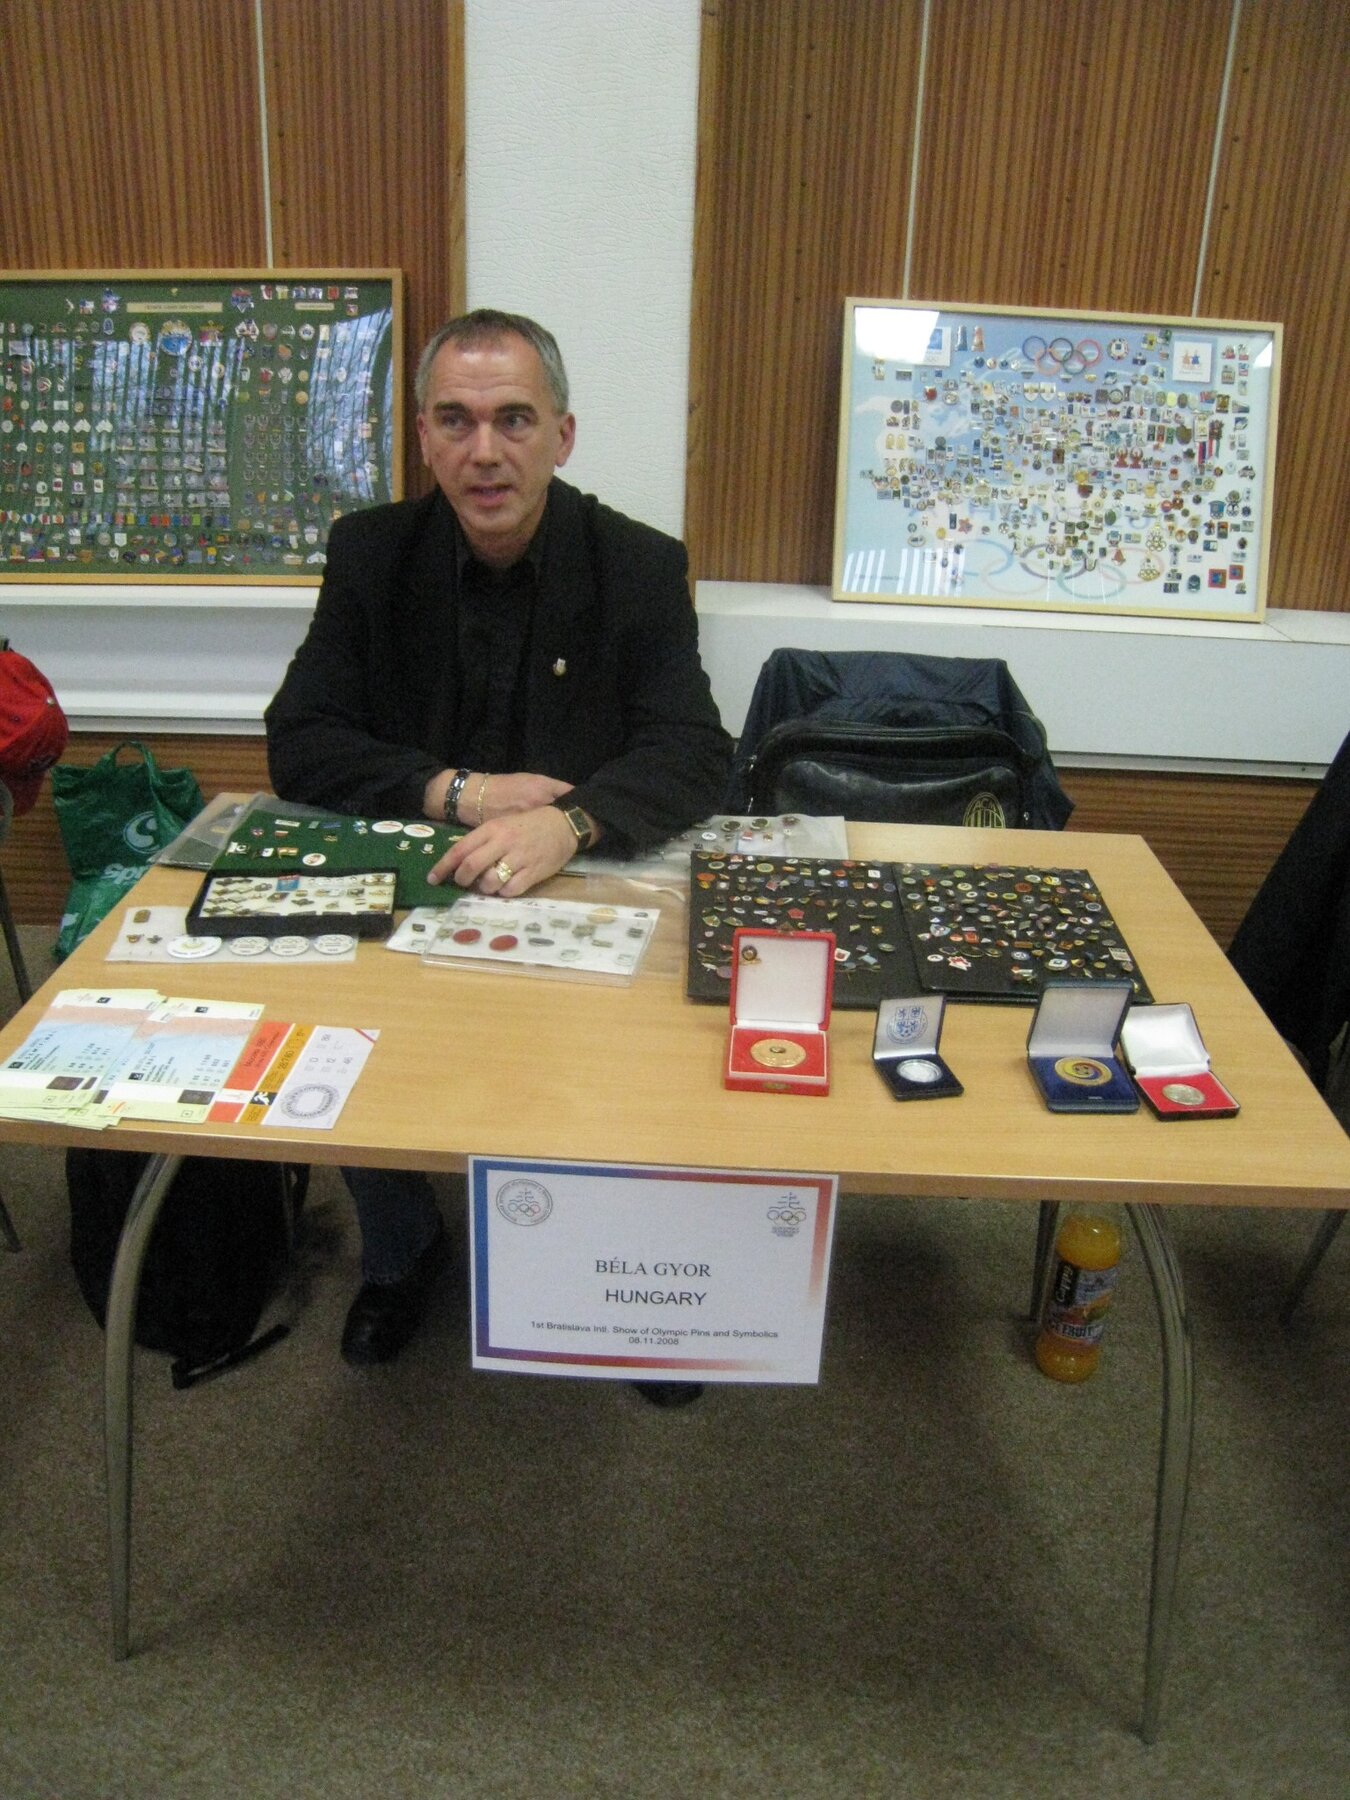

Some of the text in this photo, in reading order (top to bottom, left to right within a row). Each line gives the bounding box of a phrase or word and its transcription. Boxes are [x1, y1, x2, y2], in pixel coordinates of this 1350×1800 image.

[595, 1256, 711, 1277] BÉLA GYOR
[605, 1288, 707, 1305] HUNGARY
[531, 1321, 544, 1329] 1st
[546, 1321, 591, 1332] Bratislava
[612, 1326, 638, 1335] Show
[640, 1327, 649, 1335] of
[651, 1327, 688, 1338] Olympic
[690, 1328, 711, 1337] Pins
[713, 1329, 730, 1338] and
[732, 1329, 778, 1340] Symbolics
